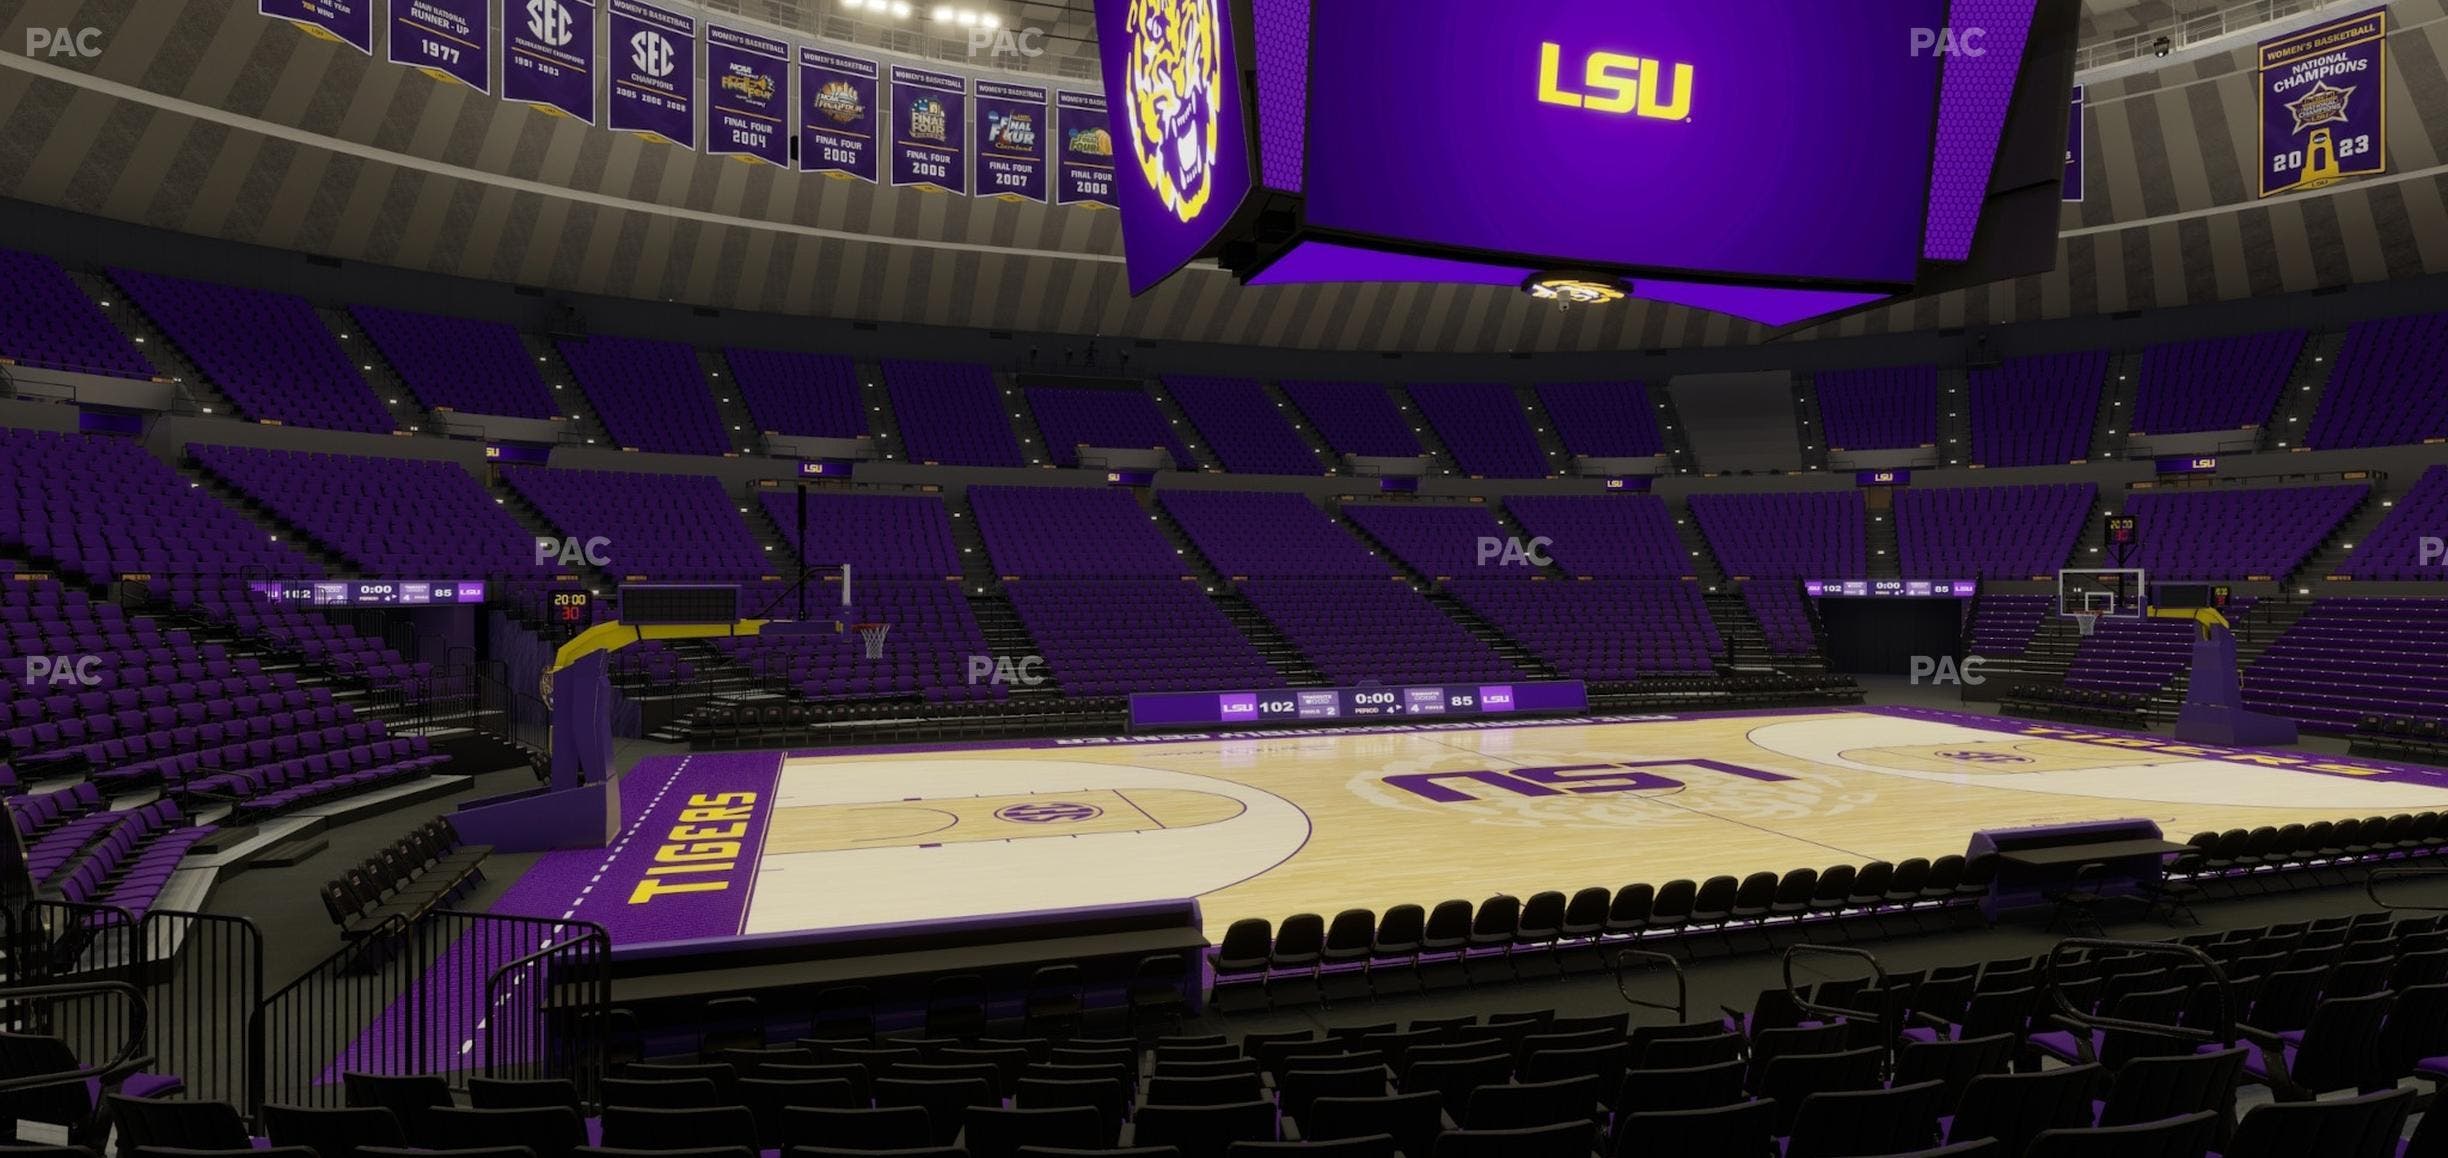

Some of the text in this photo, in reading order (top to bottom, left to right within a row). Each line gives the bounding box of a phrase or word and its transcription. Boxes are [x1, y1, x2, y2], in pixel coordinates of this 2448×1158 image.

[433, 6, 467, 26] NATIONAL
[526, 0, 573, 46] SEC
[648, 10, 691, 30] BASKETBALL
[711, 29, 785, 54] WOMEN'S BASKETBALL
[2267, 23, 2376, 61] WOMEN'S BASKETBALL
[422, 39, 460, 65] 1977
[630, 30, 675, 77] SEC
[803, 52, 874, 73] WOMEN'S BASKETBALL
[2292, 52, 2349, 75] NATIONAL
[631, 73, 674, 91] CHAMPIONS
[895, 71, 962, 88] WOMEN'S BASKETBALL
[1538, 42, 1694, 121] LSU
[2273, 59, 2368, 94] CHAMPIONS
[979, 85, 1043, 99] WOMEN'S BASKETBALL
[1061, 95, 1088, 105] WOMEN'S
[724, 116, 773, 134] FINAL FOUR
[912, 111, 945, 124] FINAL
[912, 123, 945, 135] FOUR
[732, 129, 767, 148] 2004
[816, 135, 862, 151] FINAL FOUR
[824, 148, 856, 164] 2005
[907, 150, 951, 164] FINAL FOUR
[2273, 134, 2370, 173] 20 23
[912, 162, 946, 178] 2006
[989, 161, 1033, 173] FINAL FOUR
[996, 173, 1028, 187] 2007
[1071, 170, 1113, 181] FINAL FOUR
[1077, 182, 1108, 195] 2008
[804, 464, 823, 473] LSU
[2192, 459, 2215, 469] LSU
[1607, 480, 1623, 488] LSU
[1875, 473, 1893, 482] LSU
[361, 585, 392, 594] 0:00
[434, 588, 452, 598] 85
[1823, 585, 1842, 593] 102
[1876, 582, 1900, 590] 0:00
[1935, 585, 1949, 593] 85
[562, 606, 580, 620] 30
[1223, 692, 1510, 713] LSU 102 0:00 85 LSU
[1386, 706, 1394, 714] 4
[1410, 704, 1420, 713] 4
[1326, 706, 1336, 716] 2
[1381, 758, 1801, 803] LSU
[627, 791, 758, 905] TIGERS
